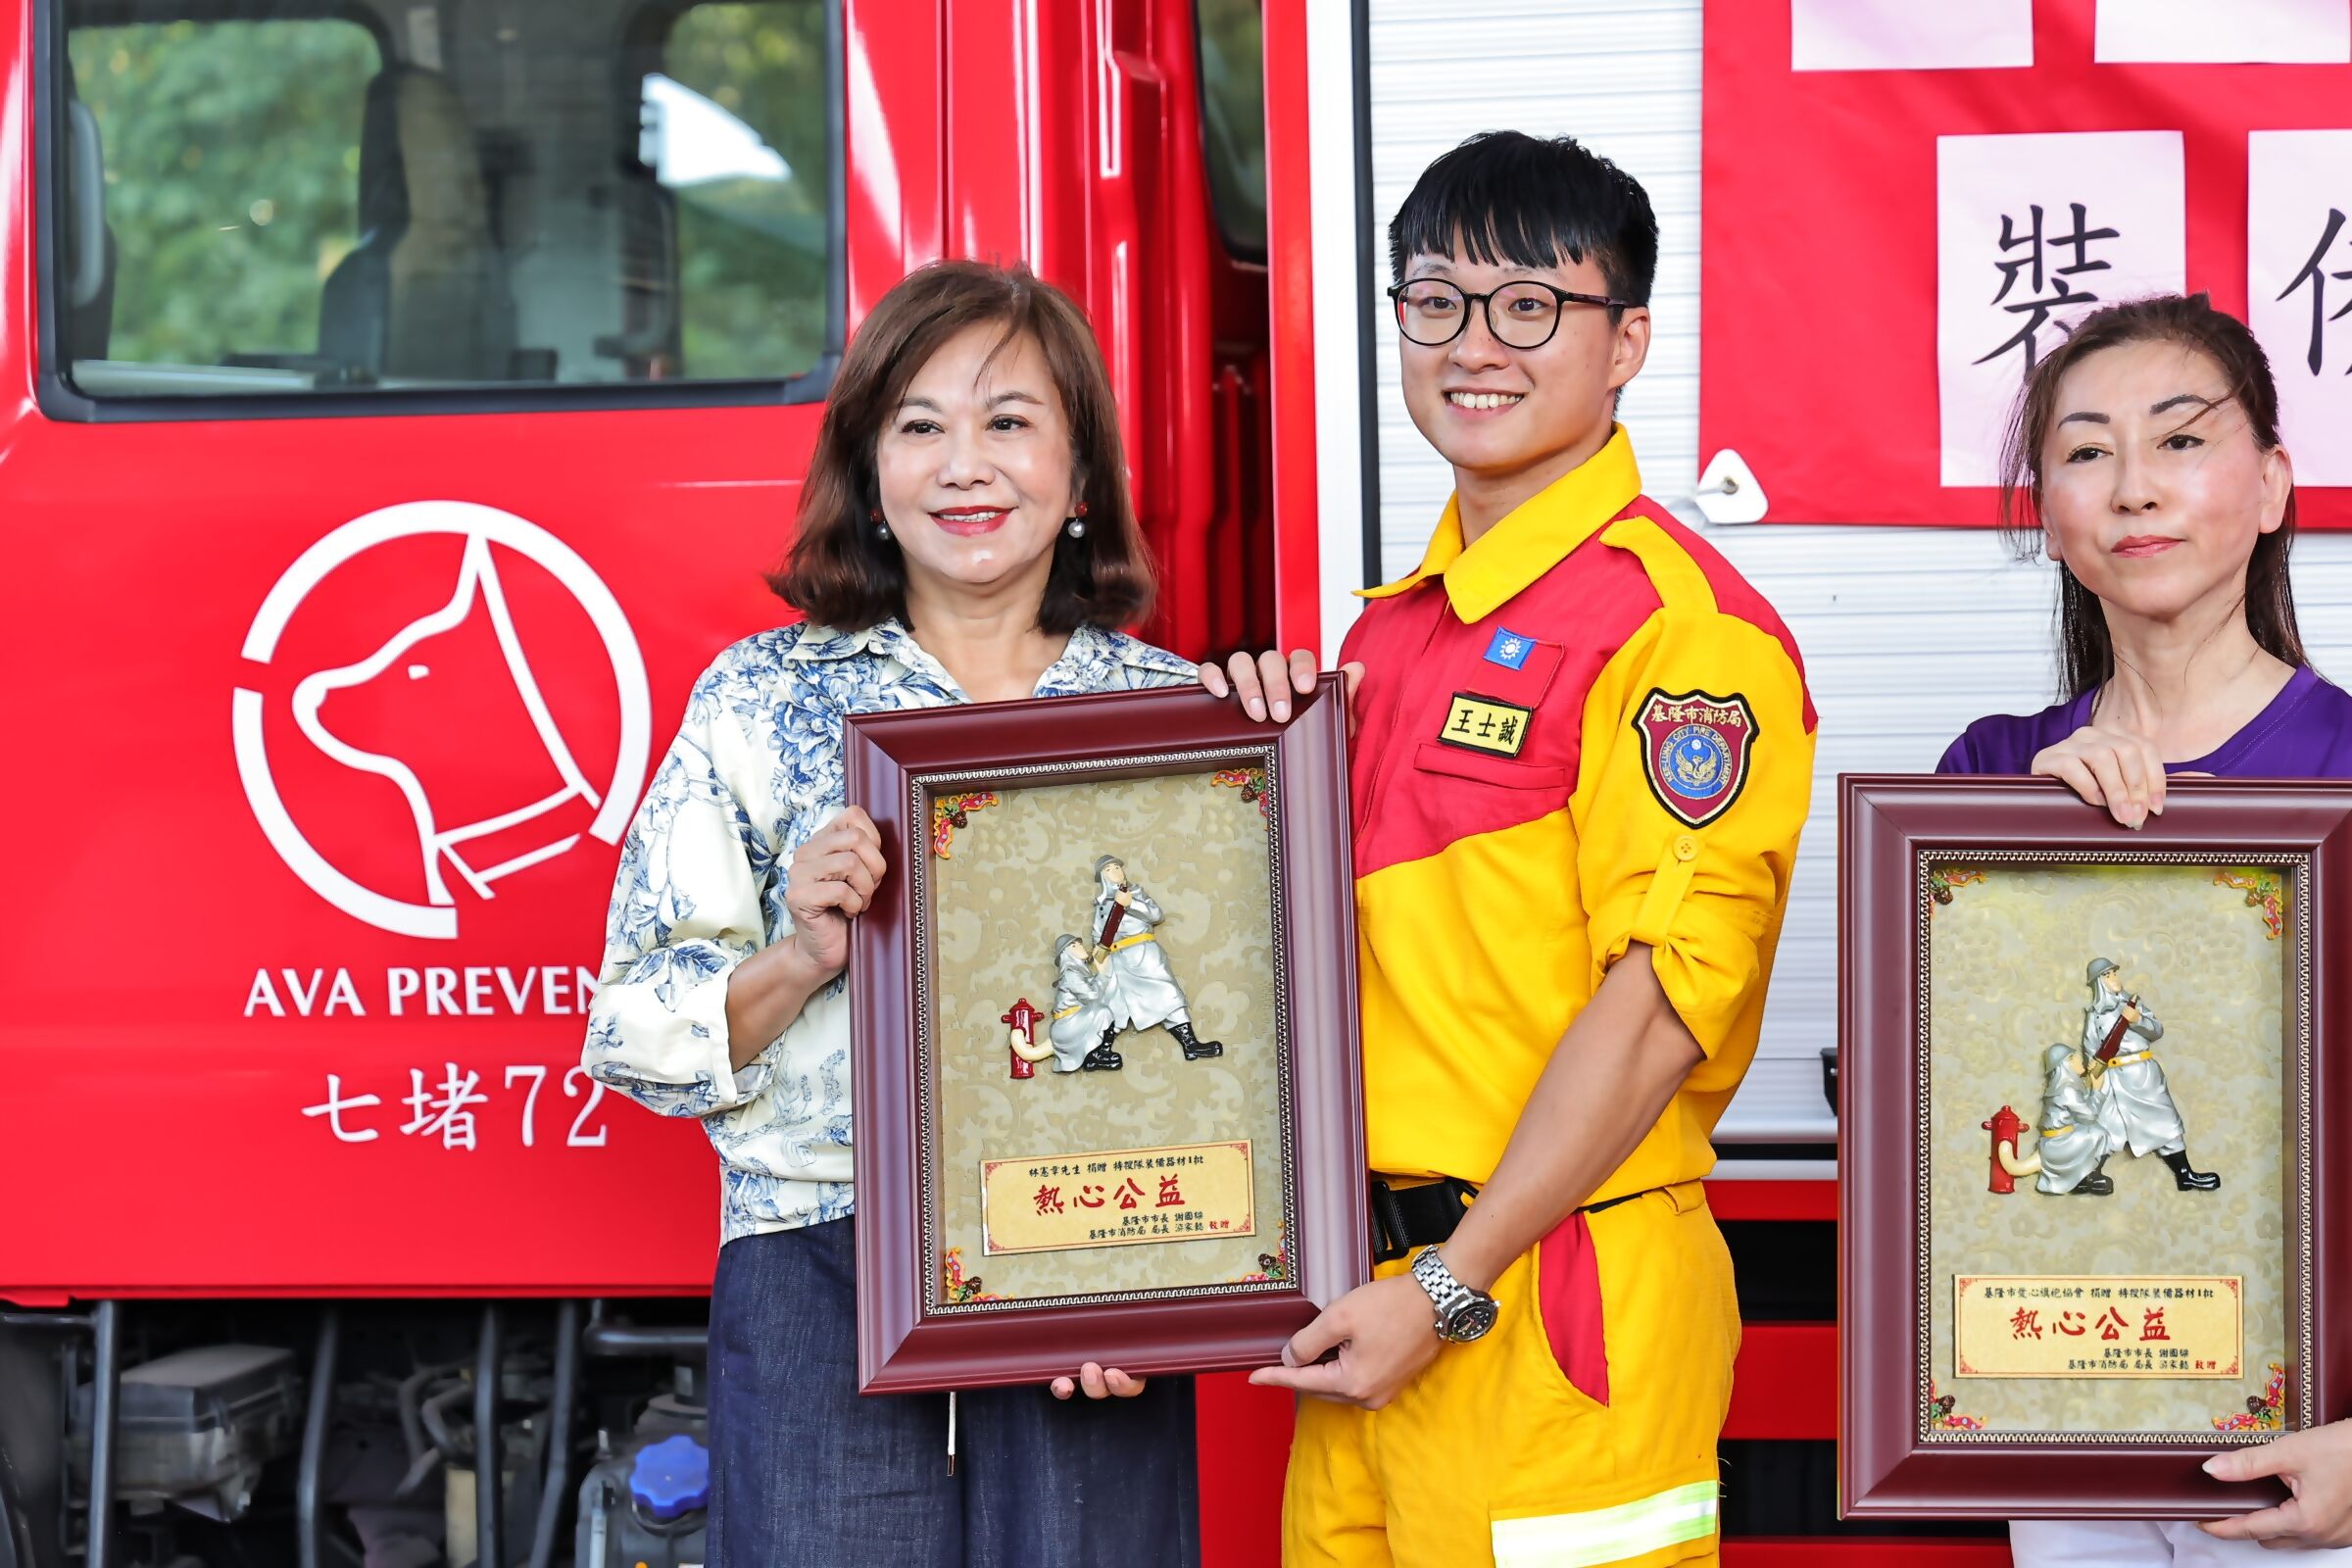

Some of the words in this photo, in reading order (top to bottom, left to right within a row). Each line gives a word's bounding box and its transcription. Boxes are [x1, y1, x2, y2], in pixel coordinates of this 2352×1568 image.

[1650, 704, 1741, 727] 基隆市消防局
[1451, 710, 1518, 745] 王士誠
[1673, 726, 1690, 740] CITY
[1693, 726, 1711, 736] FIRE
[243, 967, 367, 1017] AVA
[1087, 1161, 1107, 1174] 捐贈
[1033, 1173, 1186, 1216] 熱心公益
[1122, 1213, 1169, 1226] 基隆市市長
[1089, 1227, 1146, 1240] 基隆市消防局
[1152, 1224, 1169, 1234] 局長
[2090, 1287, 2111, 1298] 捐贈
[2010, 1305, 2171, 1341] 熱心公益
[2103, 1348, 2153, 1357] 基隆市市長
[2068, 1359, 2129, 1370] 基隆市消防局
[2133, 1359, 2153, 1370] 局長
